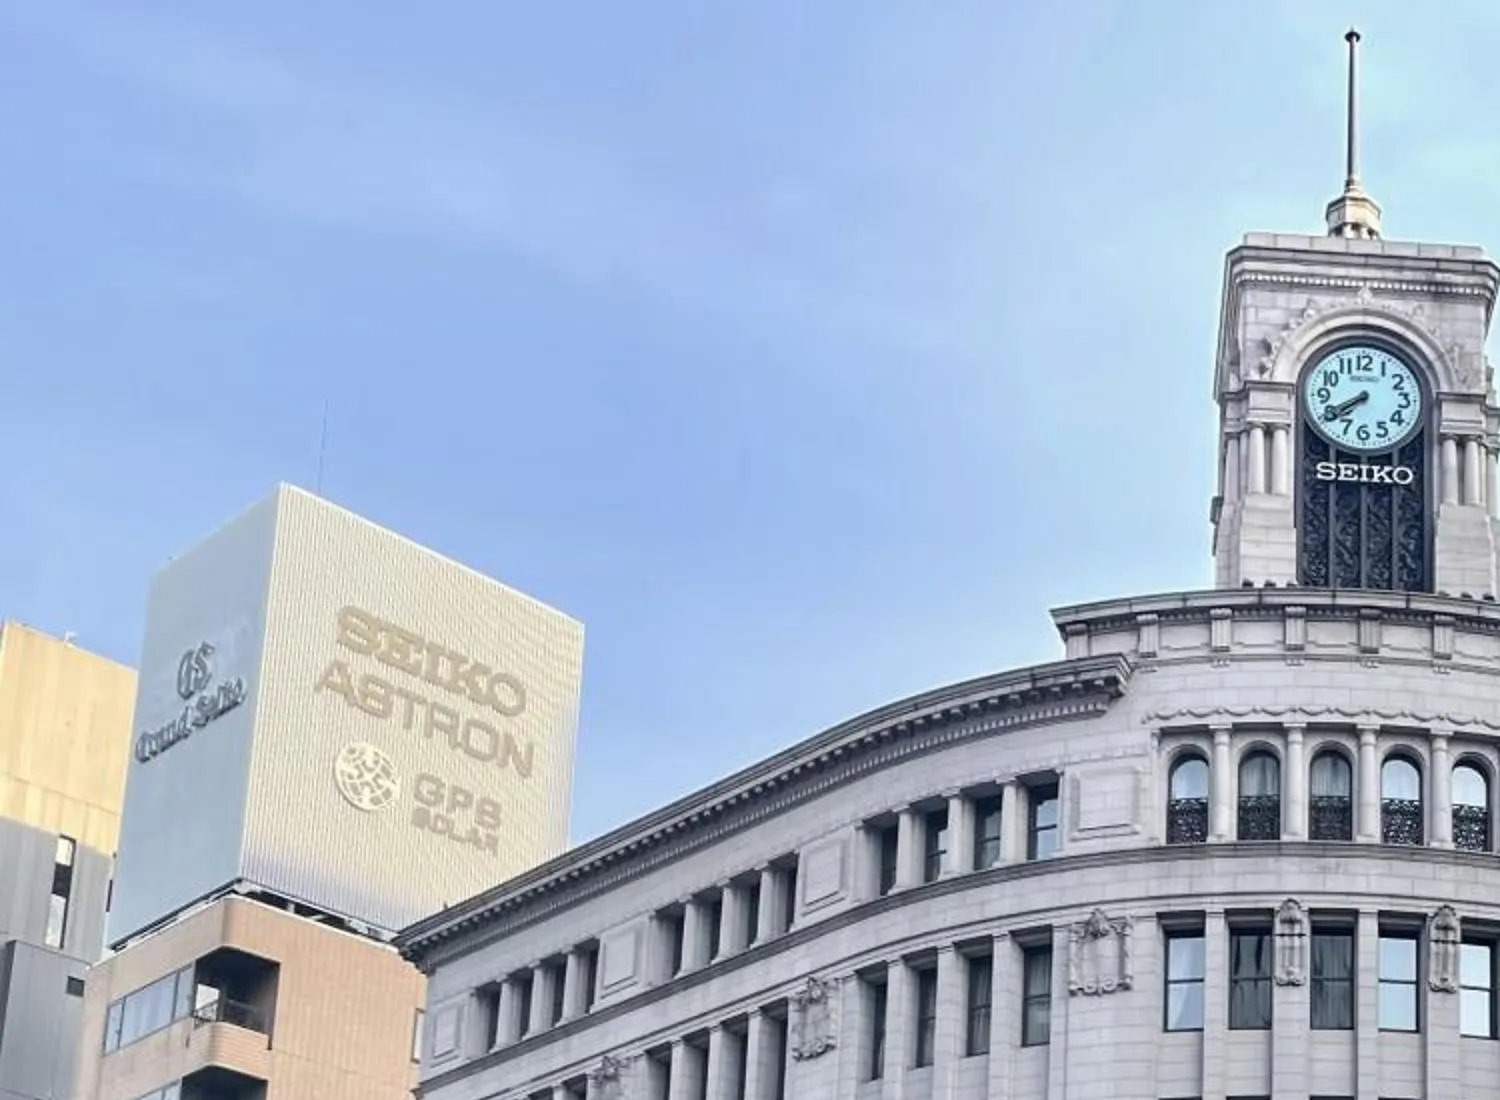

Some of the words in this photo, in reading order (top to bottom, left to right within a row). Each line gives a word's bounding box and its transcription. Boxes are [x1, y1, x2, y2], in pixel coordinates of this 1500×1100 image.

[1340, 358, 1353, 375] 11
[1356, 355, 1374, 372] 12
[1381, 361, 1387, 378] 1
[1323, 370, 1339, 387] 10
[1391, 374, 1405, 391] 2
[1317, 388, 1331, 404] 9
[1398, 391, 1411, 409] 3
[1390, 410, 1405, 426] 4
[1341, 419, 1353, 436] 7
[1356, 424, 1371, 441] 6
[1376, 421, 1389, 438] 5
[1315, 461, 1414, 485] SEIKO
[337, 605, 527, 717] SEIKO
[313, 660, 535, 779] ASTRON
[413, 772, 501, 829] GPS
[411, 806, 500, 852] SOLAR
